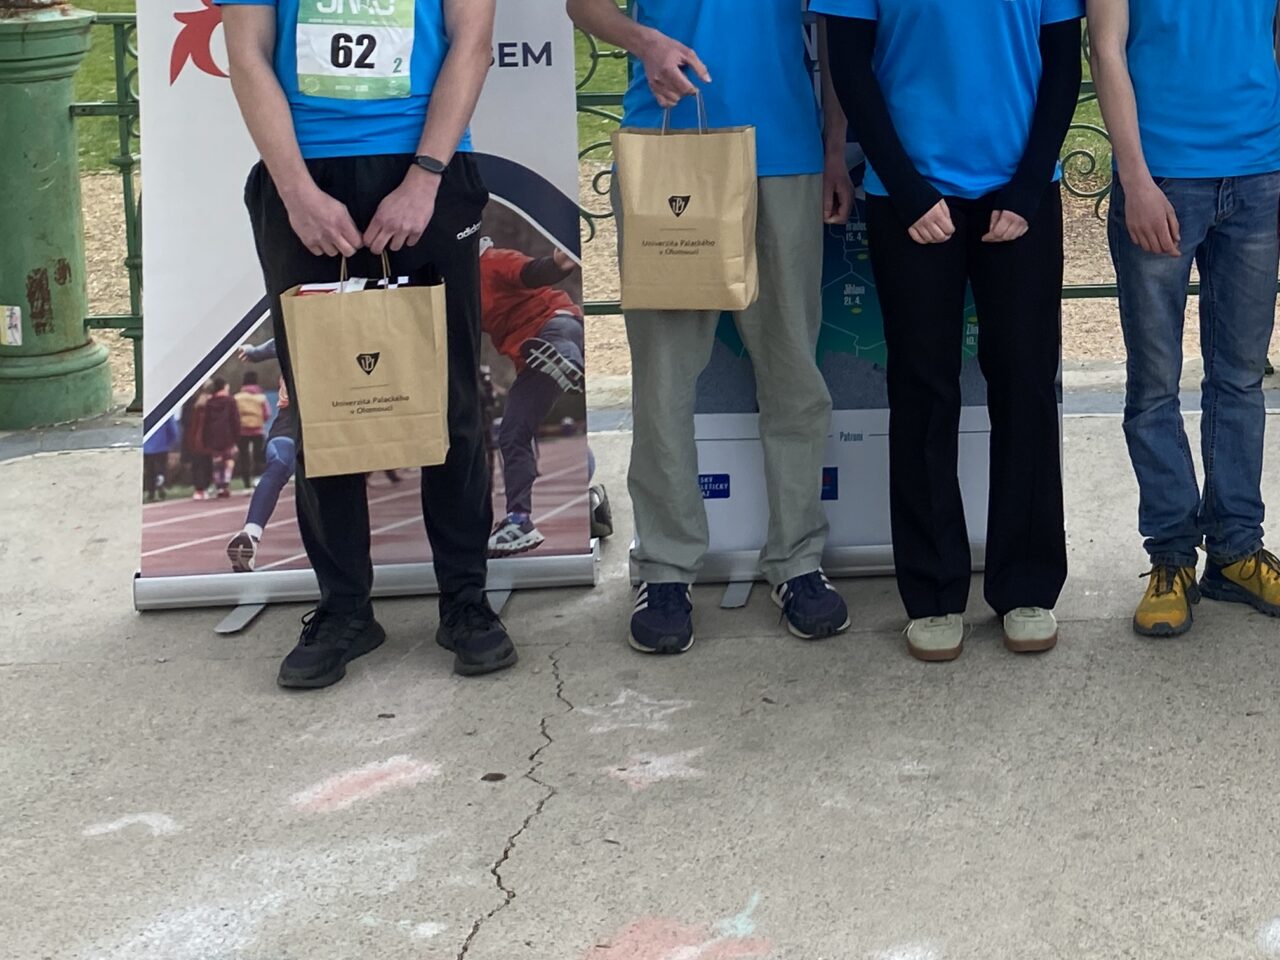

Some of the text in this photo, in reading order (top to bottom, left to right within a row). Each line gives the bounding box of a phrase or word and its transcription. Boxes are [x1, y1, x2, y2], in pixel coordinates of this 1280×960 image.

[330, 32, 377, 69] 62
[489, 41, 552, 68] EM
[392, 57, 403, 74] 2
[456, 220, 482, 240] adida
